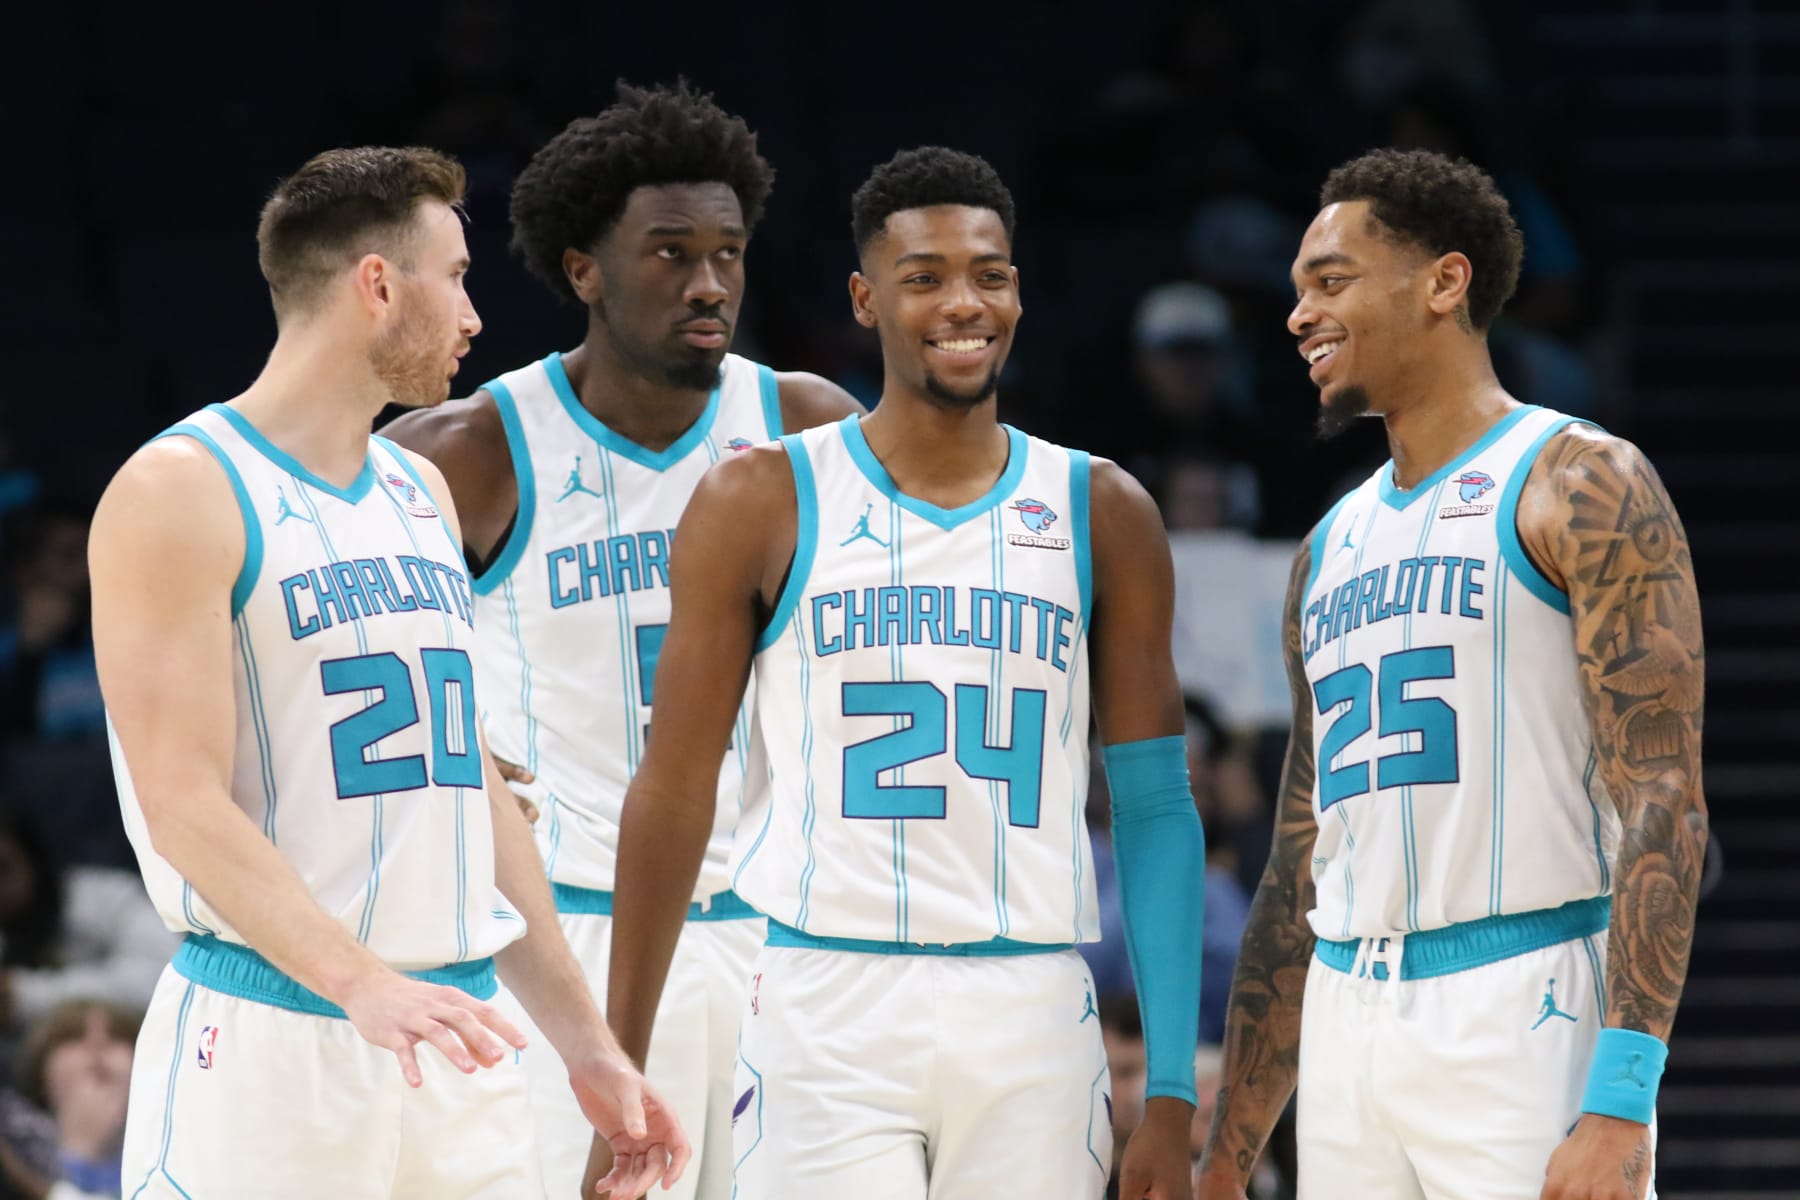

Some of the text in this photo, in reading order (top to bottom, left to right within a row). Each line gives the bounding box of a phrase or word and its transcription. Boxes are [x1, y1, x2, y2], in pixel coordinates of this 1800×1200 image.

[1008, 533, 1070, 550] FEASTABLES
[1439, 504, 1494, 519] FEASTABLES
[545, 527, 677, 610] CHAR
[1303, 555, 1486, 665] CHARLOTTE
[811, 585, 1074, 673] CHARLOTTE
[320, 647, 483, 800] 20
[841, 681, 1048, 829] 24
[1313, 645, 1460, 813] 25
